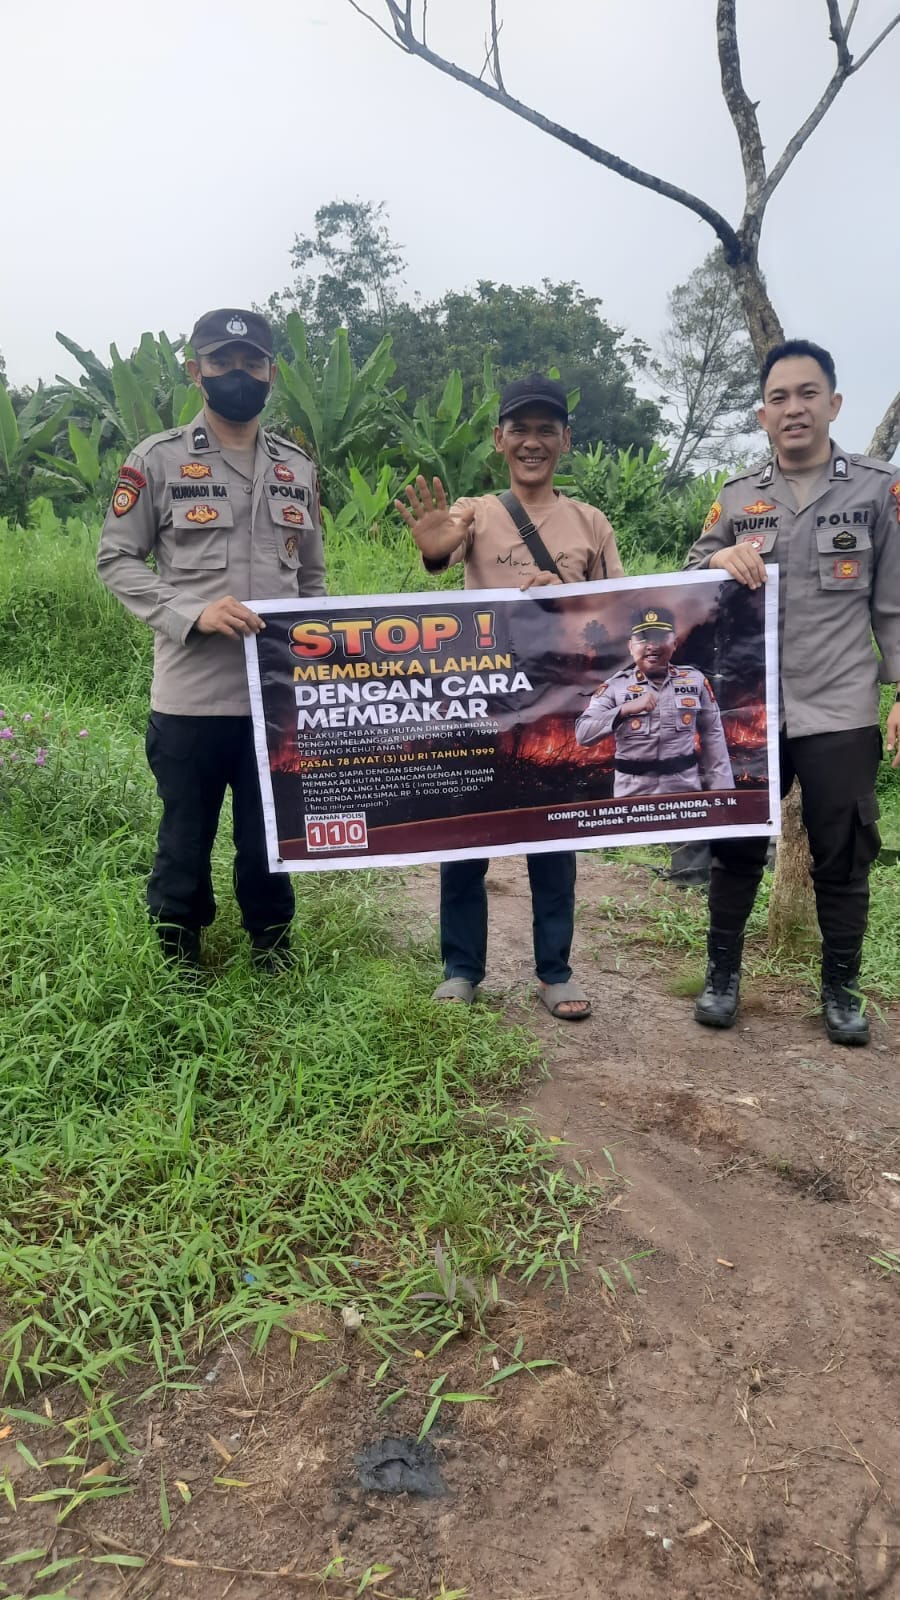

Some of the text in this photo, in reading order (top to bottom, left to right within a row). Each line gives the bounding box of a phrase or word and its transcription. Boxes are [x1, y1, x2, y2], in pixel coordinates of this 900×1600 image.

[734, 516, 779, 532] TAUFIK
[817, 511, 868, 526] POLRI
[291, 613, 493, 658] STOP !
[293, 654, 512, 682] MEMBUKA LAHAN
[294, 672, 533, 706] DENGAN CARA
[674, 686, 698, 694] POLRI
[297, 698, 489, 730] MEMBAKAR
[298, 732, 334, 740] PELAKU
[337, 728, 389, 738] PEMBAKAR
[392, 726, 422, 734] HUTAN
[464, 720, 500, 728] PIDANA
[298, 740, 338, 748] DENGAN
[340, 736, 399, 746] MELANGGAR
[418, 731, 453, 740] NOMOR
[300, 748, 343, 756] TENTANG
[300, 760, 334, 768] PASAL
[337, 758, 350, 766] 78
[353, 756, 380, 764] AYAT
[383, 754, 396, 763] (3)
[400, 754, 415, 762] UU
[431, 750, 468, 759] TAHUN
[470, 747, 495, 756] 1999
[302, 772, 337, 780] BARANG
[366, 767, 401, 775] DENGAN
[404, 764, 442, 773] SENGAJA
[302, 779, 350, 788] MEMBAKAR
[386, 773, 426, 782] DIANCAM
[428, 770, 462, 779] DENGAN
[464, 767, 495, 776] PIDANA
[303, 787, 341, 796] PENJARA
[343, 785, 373, 793] PALING
[466, 776, 493, 784] TAHUN
[354, 790, 398, 800] MAKSIMAL
[357, 801, 383, 810] rupiah
[548, 810, 590, 821] KOMPOL
[599, 806, 628, 816] MADE
[631, 804, 656, 813] ARIS
[658, 799, 712, 811] CHANDRA,
[714, 798, 724, 806] S.
[578, 810, 707, 828] Kapolsek Pontianak Utara
[310, 824, 362, 843] 110
